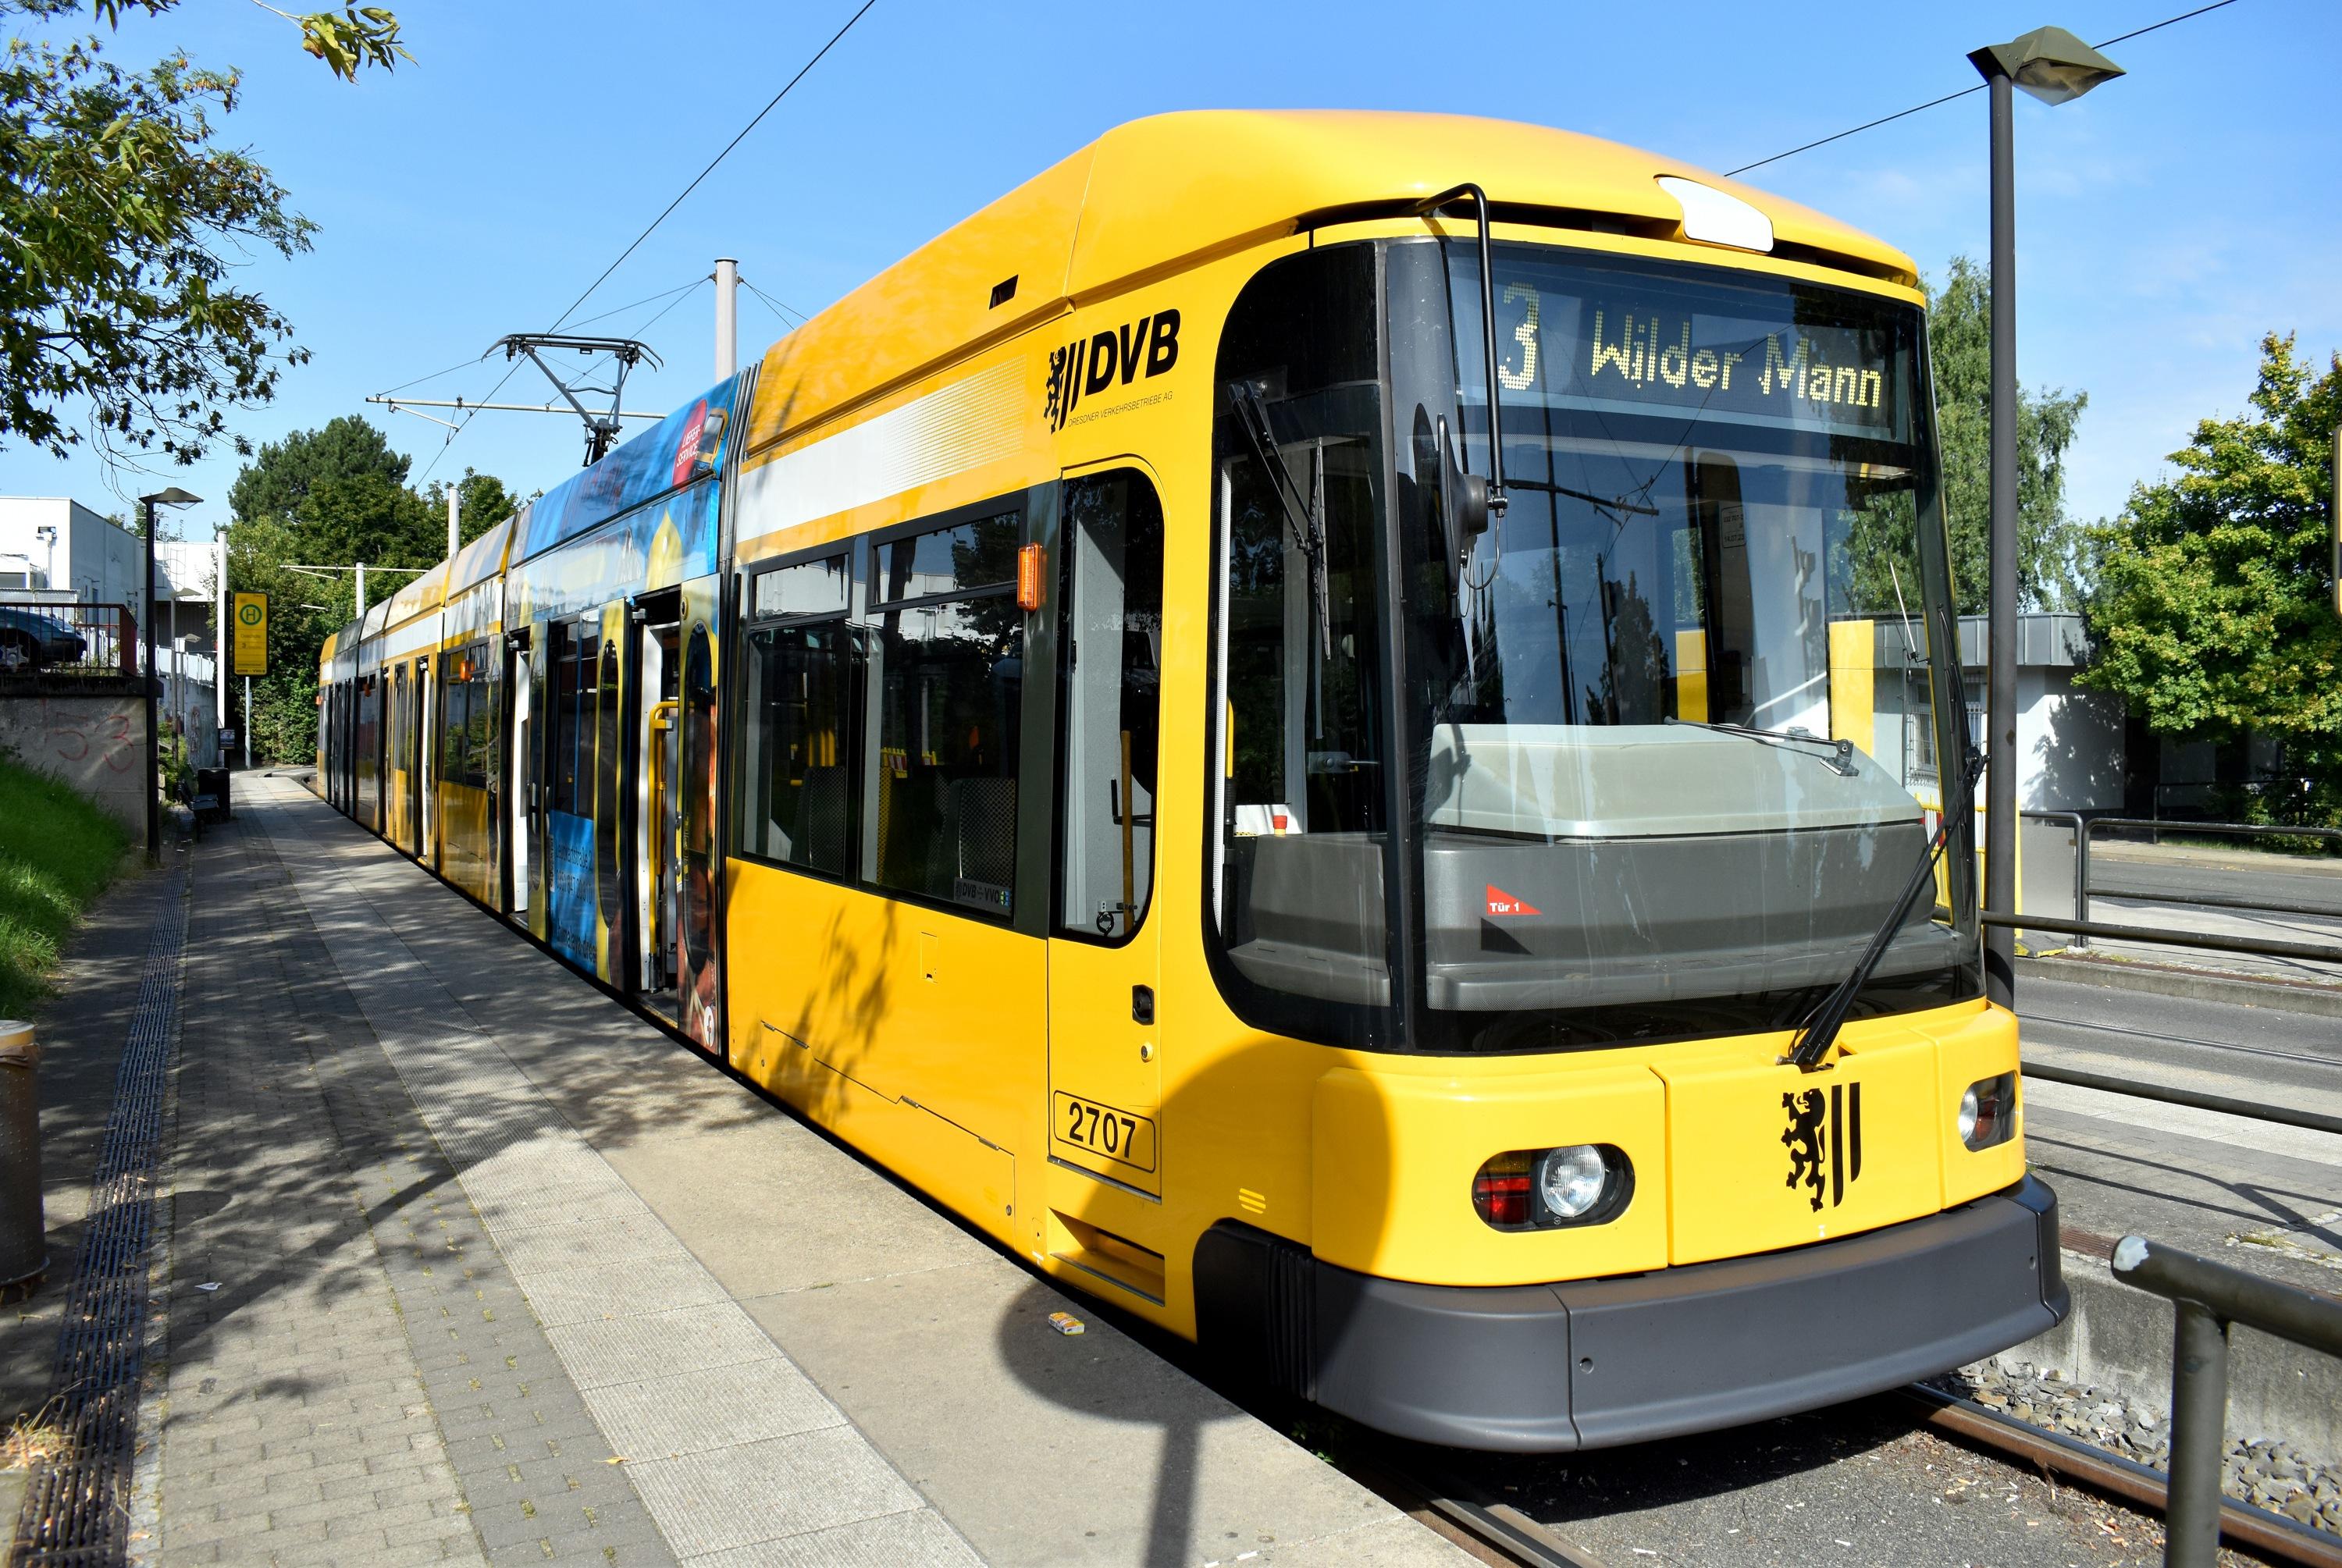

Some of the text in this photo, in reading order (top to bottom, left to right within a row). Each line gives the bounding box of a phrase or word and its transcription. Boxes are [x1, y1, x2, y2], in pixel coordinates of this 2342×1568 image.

[1084, 308, 1181, 396] DVB
[1498, 282, 1882, 408] 3 Wilder Mann
[1068, 390, 1173, 428] DRESDNER VERKEHRSBETRIEBE AG
[246, 608, 255, 621] H
[1489, 901, 1520, 912] Tür 1
[1069, 1101, 1136, 1159] 2707
